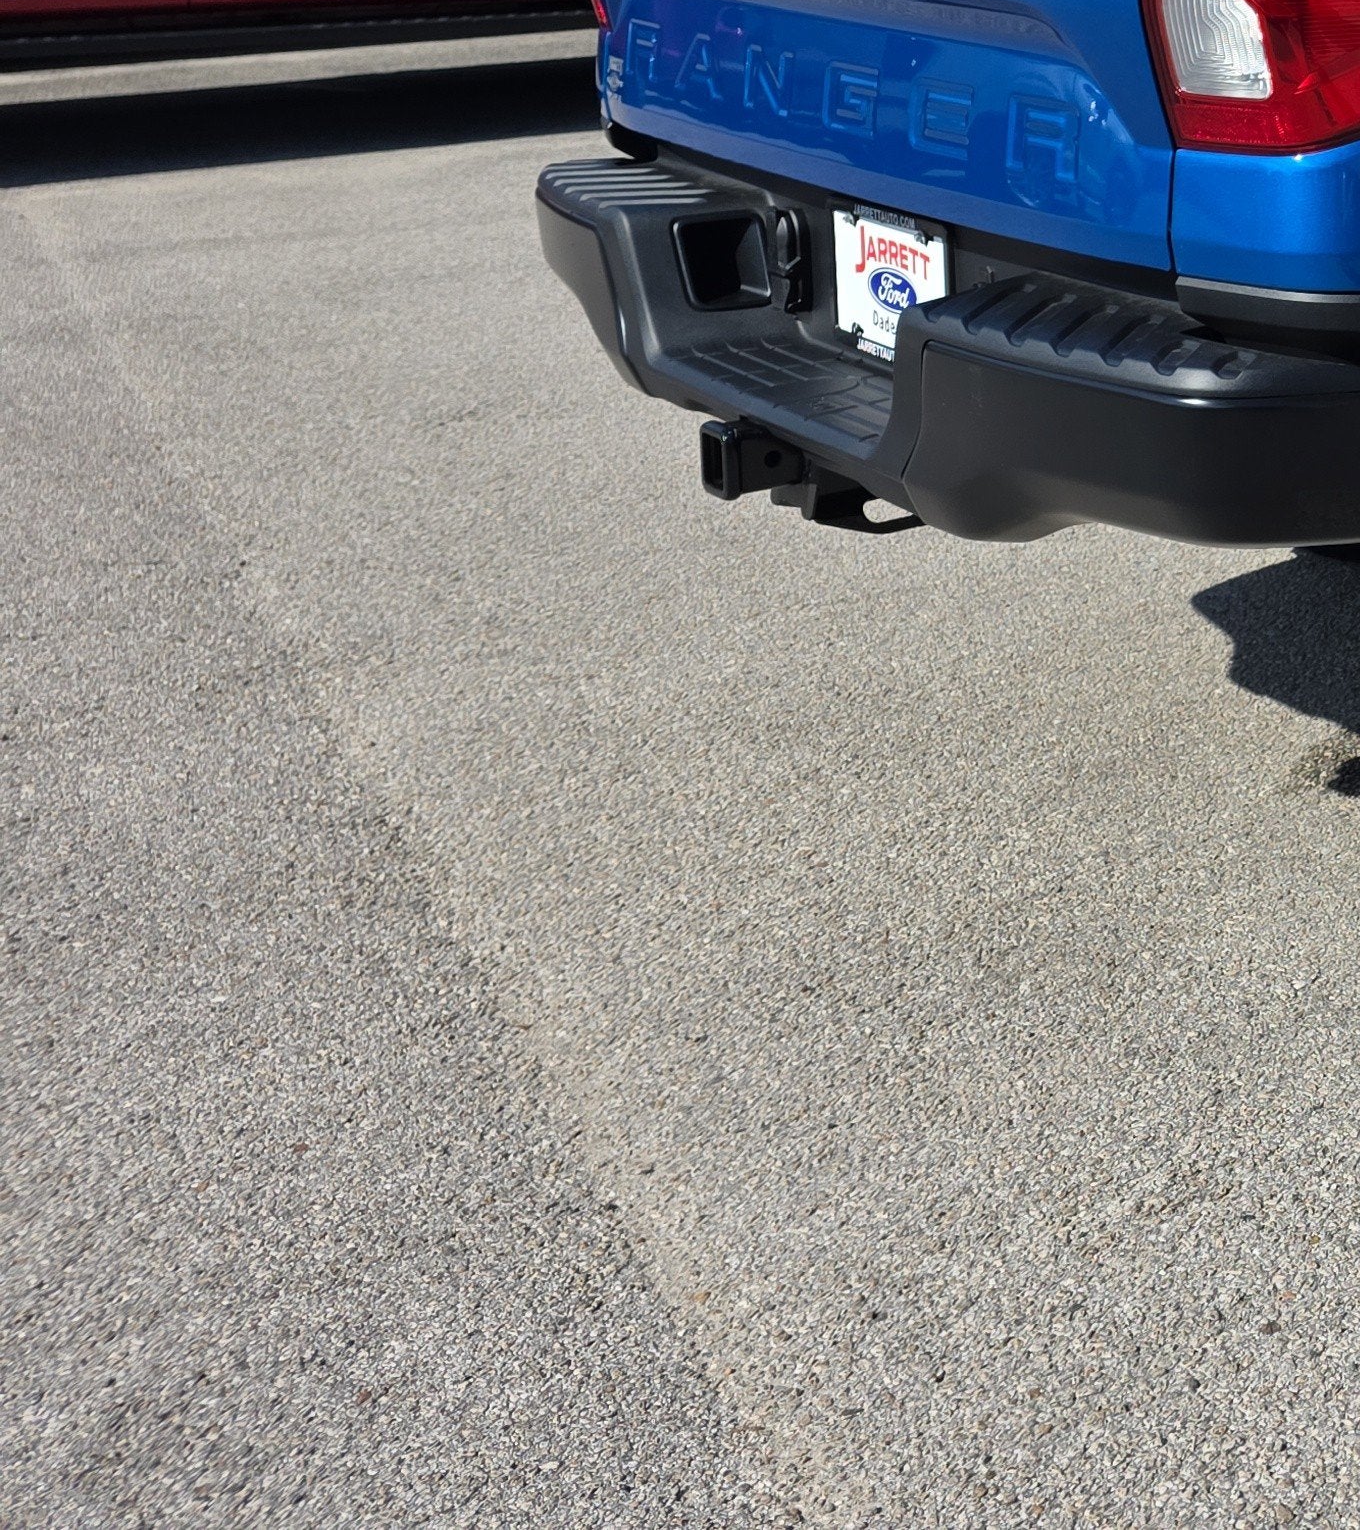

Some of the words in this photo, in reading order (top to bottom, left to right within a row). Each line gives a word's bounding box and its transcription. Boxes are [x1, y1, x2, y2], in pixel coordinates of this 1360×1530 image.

[626, 17, 1081, 183] RANGER
[855, 226, 930, 281] JARRETT
[877, 272, 910, 309] Ford
[872, 310, 897, 335] Dade
[856, 338, 896, 363] JARRETTAUT
